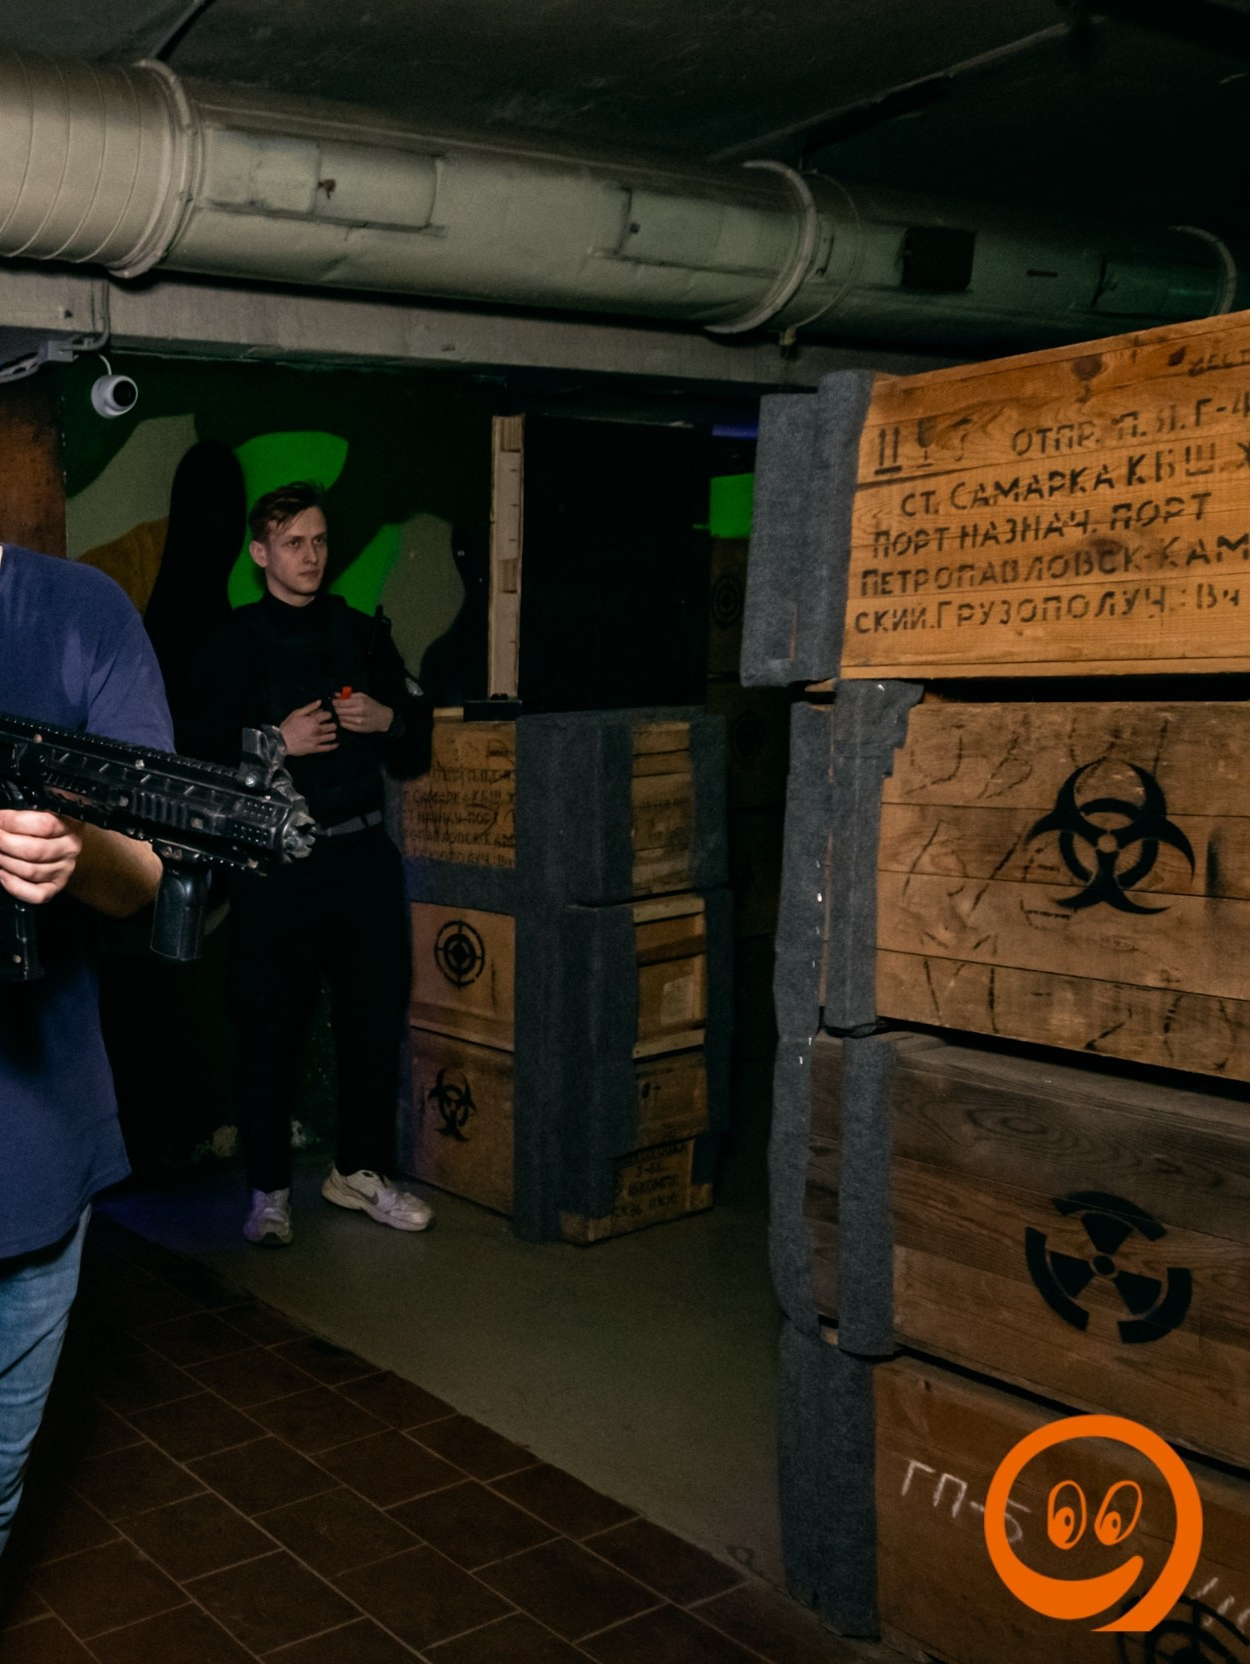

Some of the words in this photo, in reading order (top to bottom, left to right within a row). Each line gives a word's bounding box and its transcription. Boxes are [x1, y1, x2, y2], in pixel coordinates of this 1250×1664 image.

[873, 527, 950, 558] ПОРТ
[1110, 491, 1212, 531] ПОРТ
[900, 490, 940, 517] СТ.
